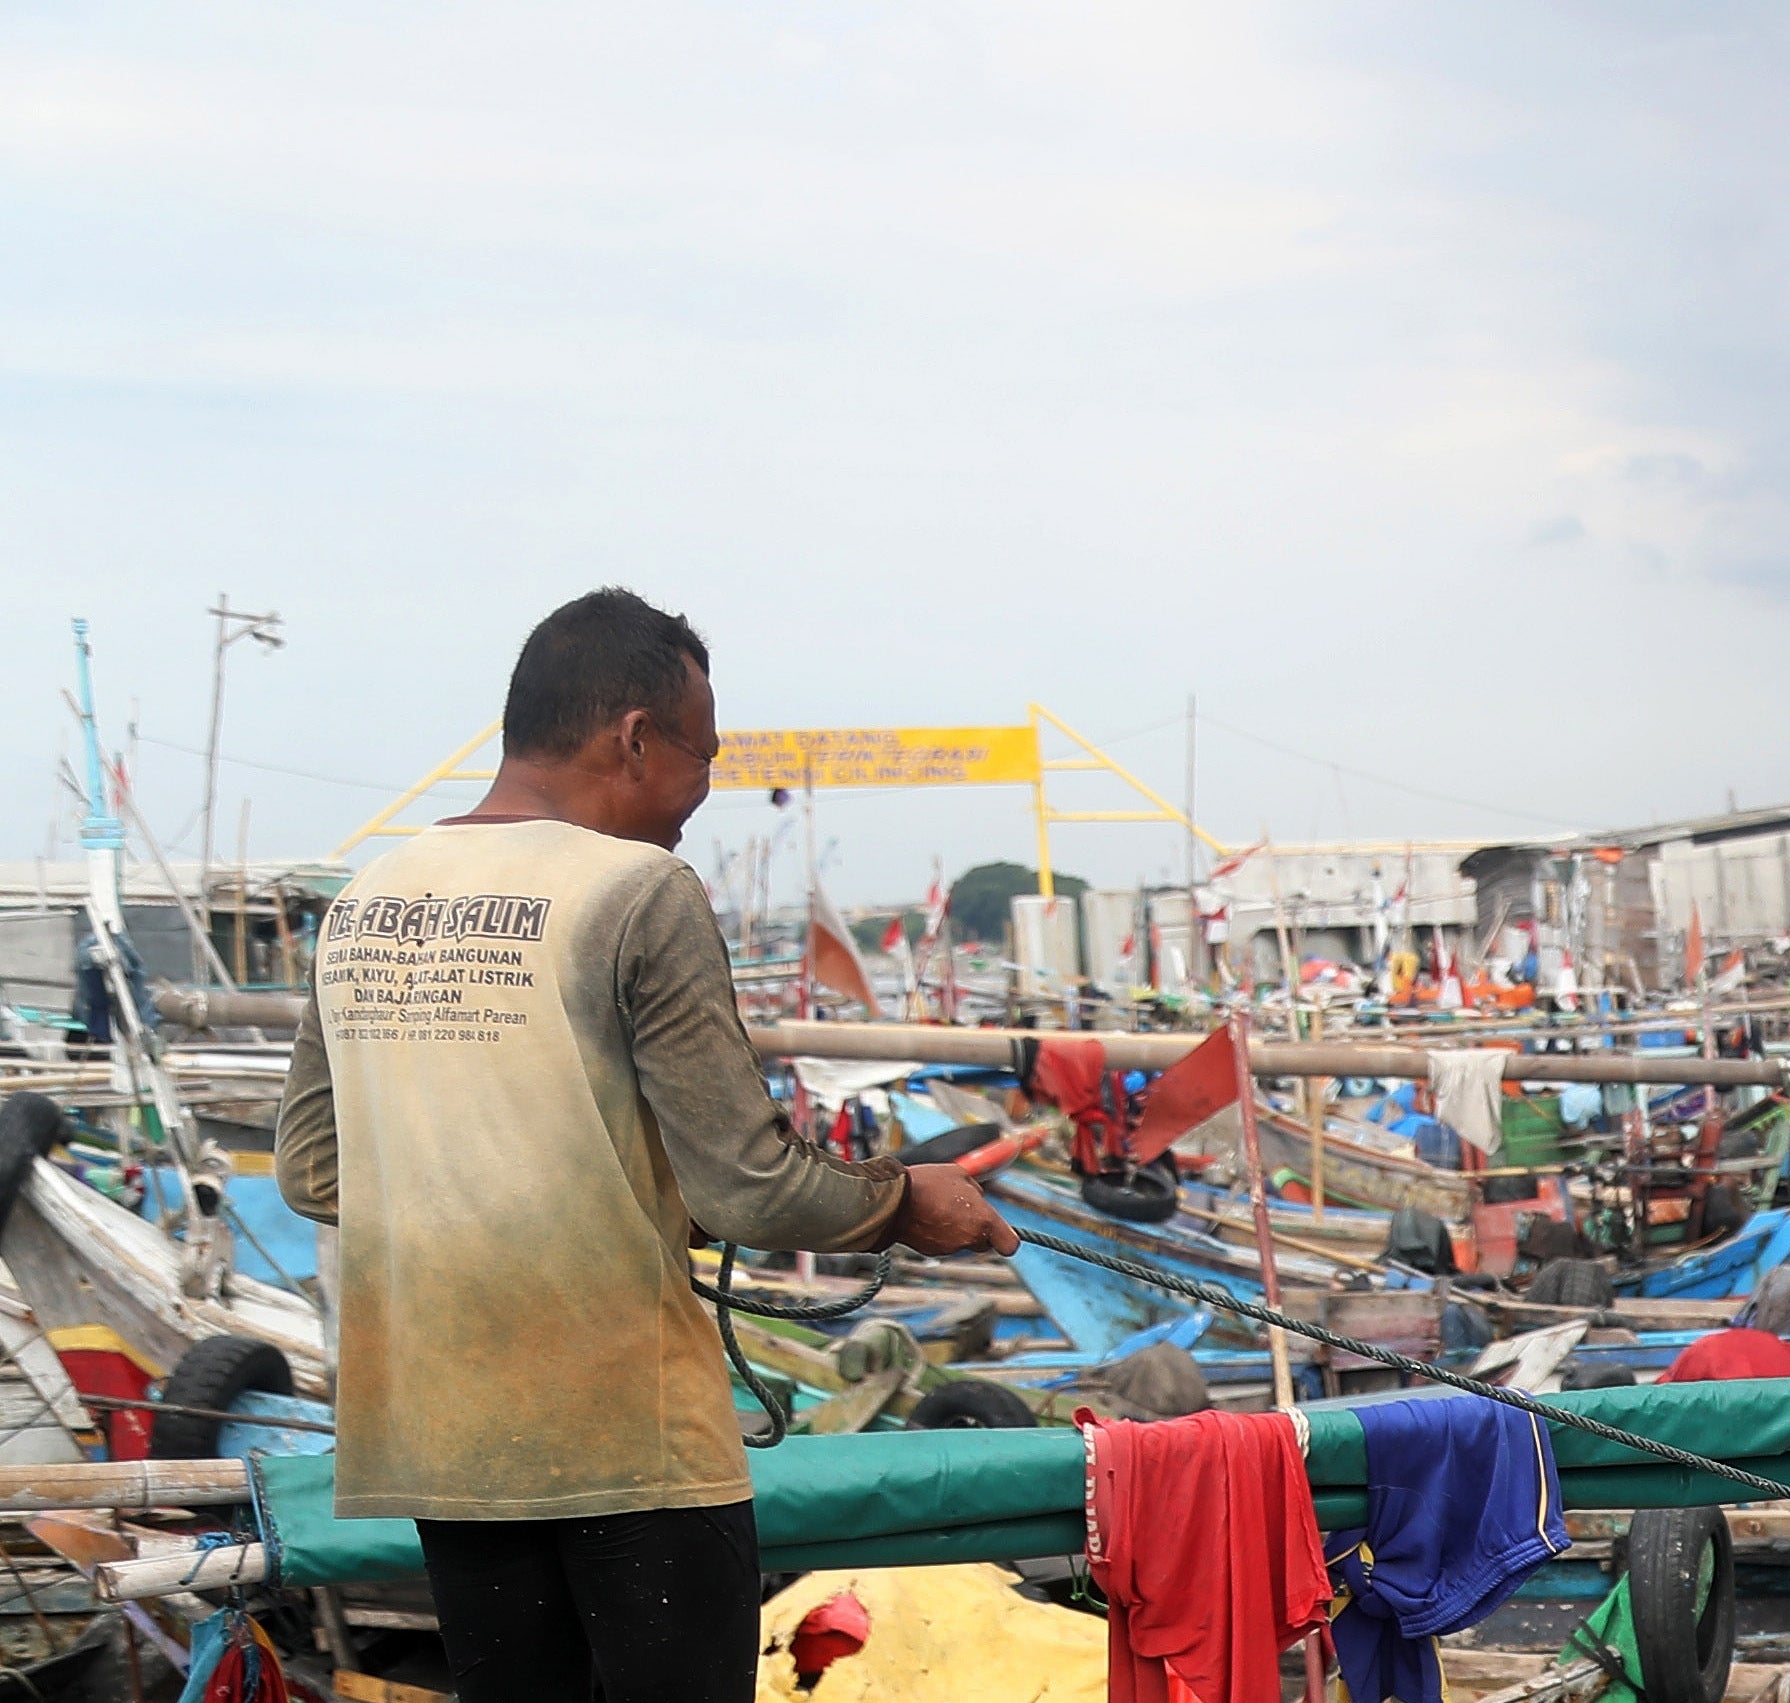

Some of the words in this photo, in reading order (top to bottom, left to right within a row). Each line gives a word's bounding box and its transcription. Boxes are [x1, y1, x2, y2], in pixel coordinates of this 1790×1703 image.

[355, 895, 450, 947] ABAH
[442, 894, 552, 943] SALIM
[440, 949, 523, 967] BANGUNAN
[469, 968, 535, 988] LISTRIK
[483, 1008, 527, 1026] Parean
[434, 1029, 456, 1042] 220
